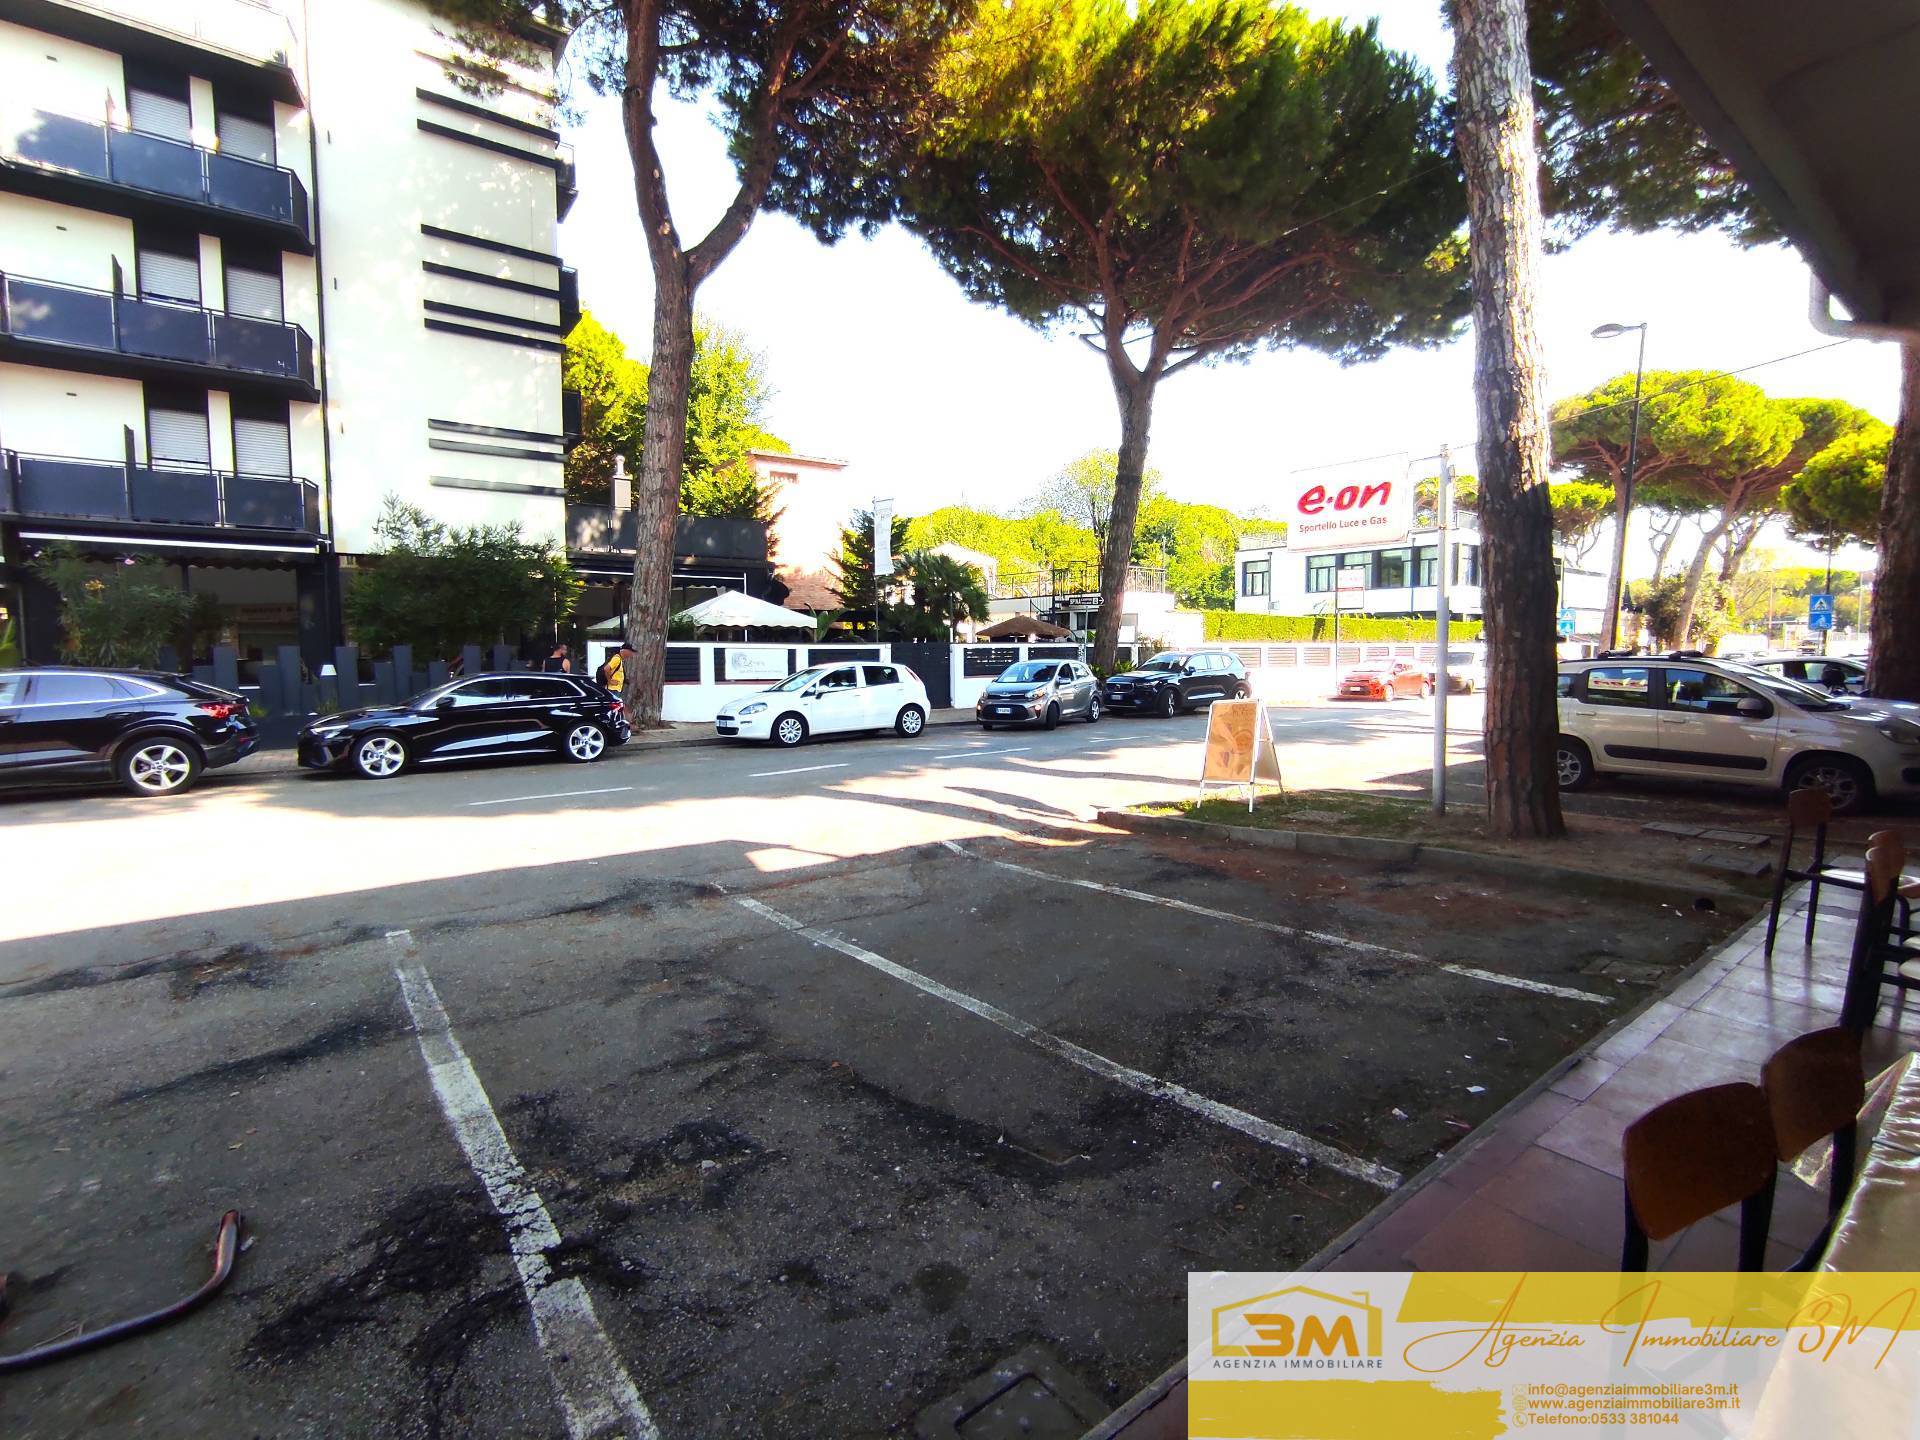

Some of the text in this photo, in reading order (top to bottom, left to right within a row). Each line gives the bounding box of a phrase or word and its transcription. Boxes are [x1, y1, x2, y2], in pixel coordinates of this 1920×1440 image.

[1299, 516, 1387, 534] Sportello Luce e Gas
